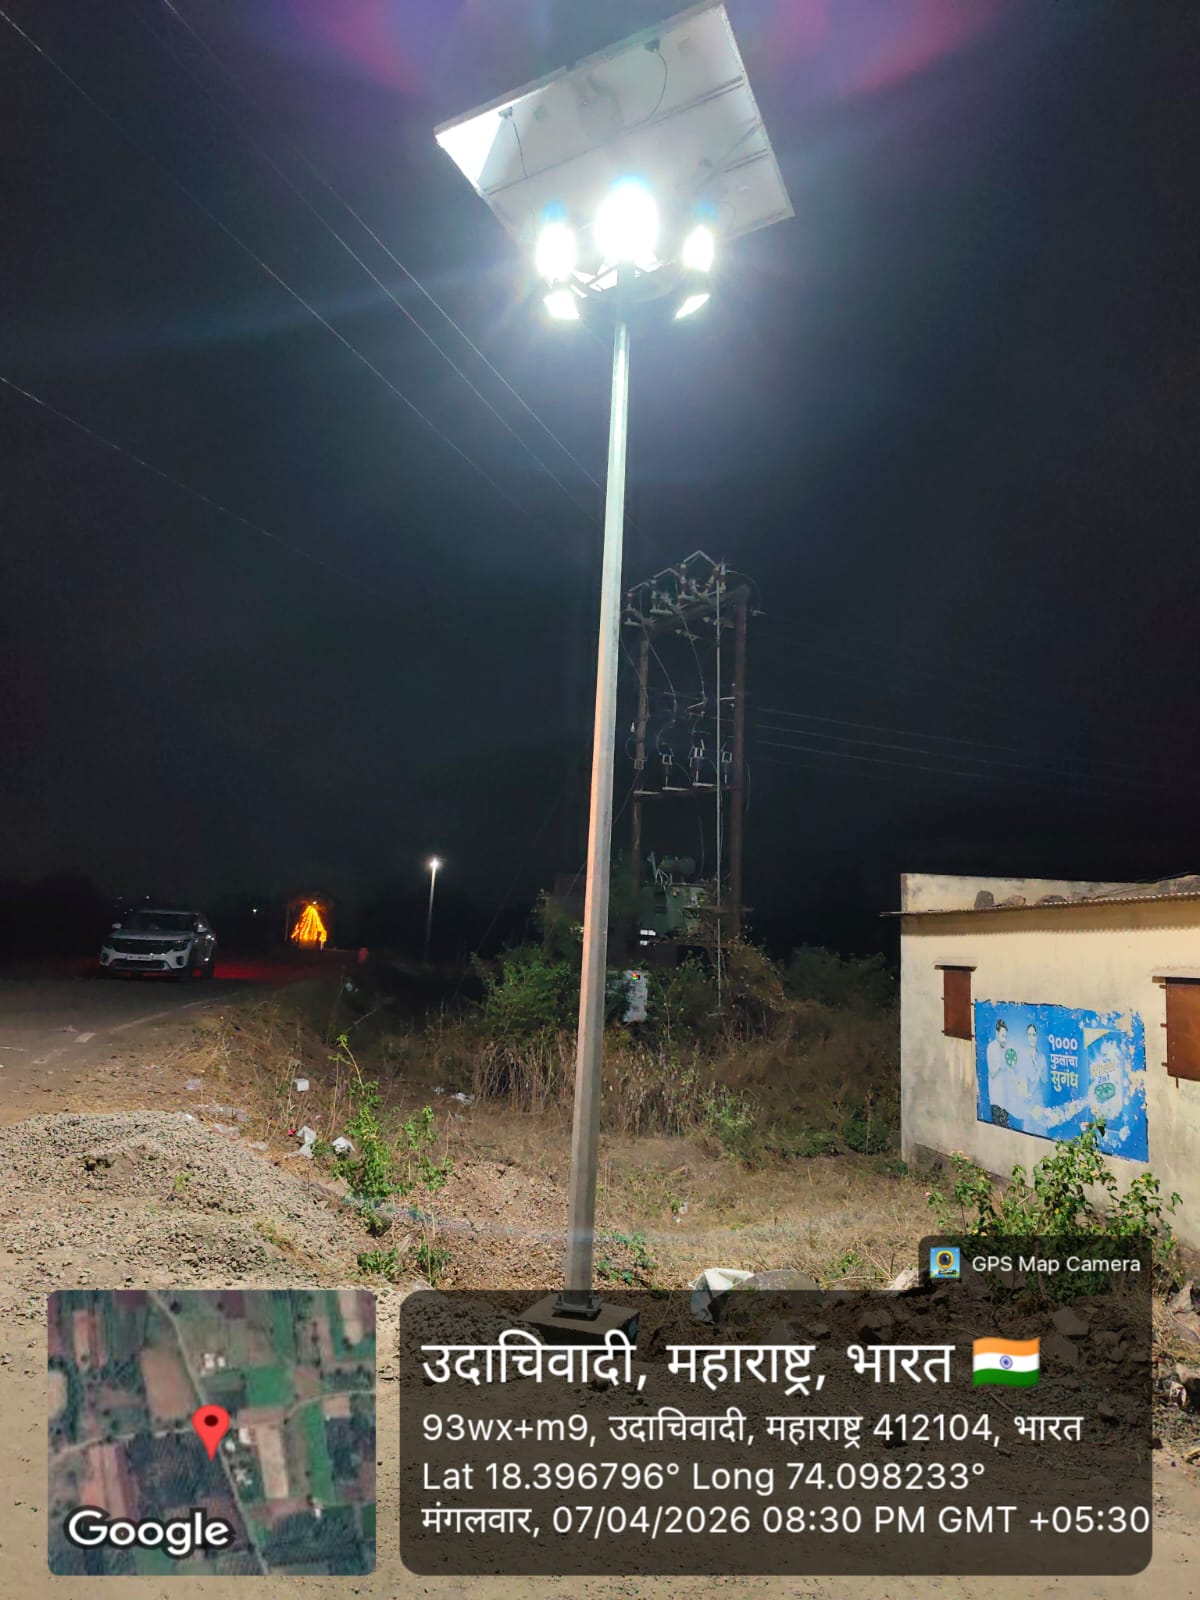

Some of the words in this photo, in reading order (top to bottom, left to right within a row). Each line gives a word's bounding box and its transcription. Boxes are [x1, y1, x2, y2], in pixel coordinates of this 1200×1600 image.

[1048, 1034, 1078, 1050] १०००
[1050, 1051, 1078, 1070] फुलांचा
[1051, 1069, 1079, 1092] सुगंध
